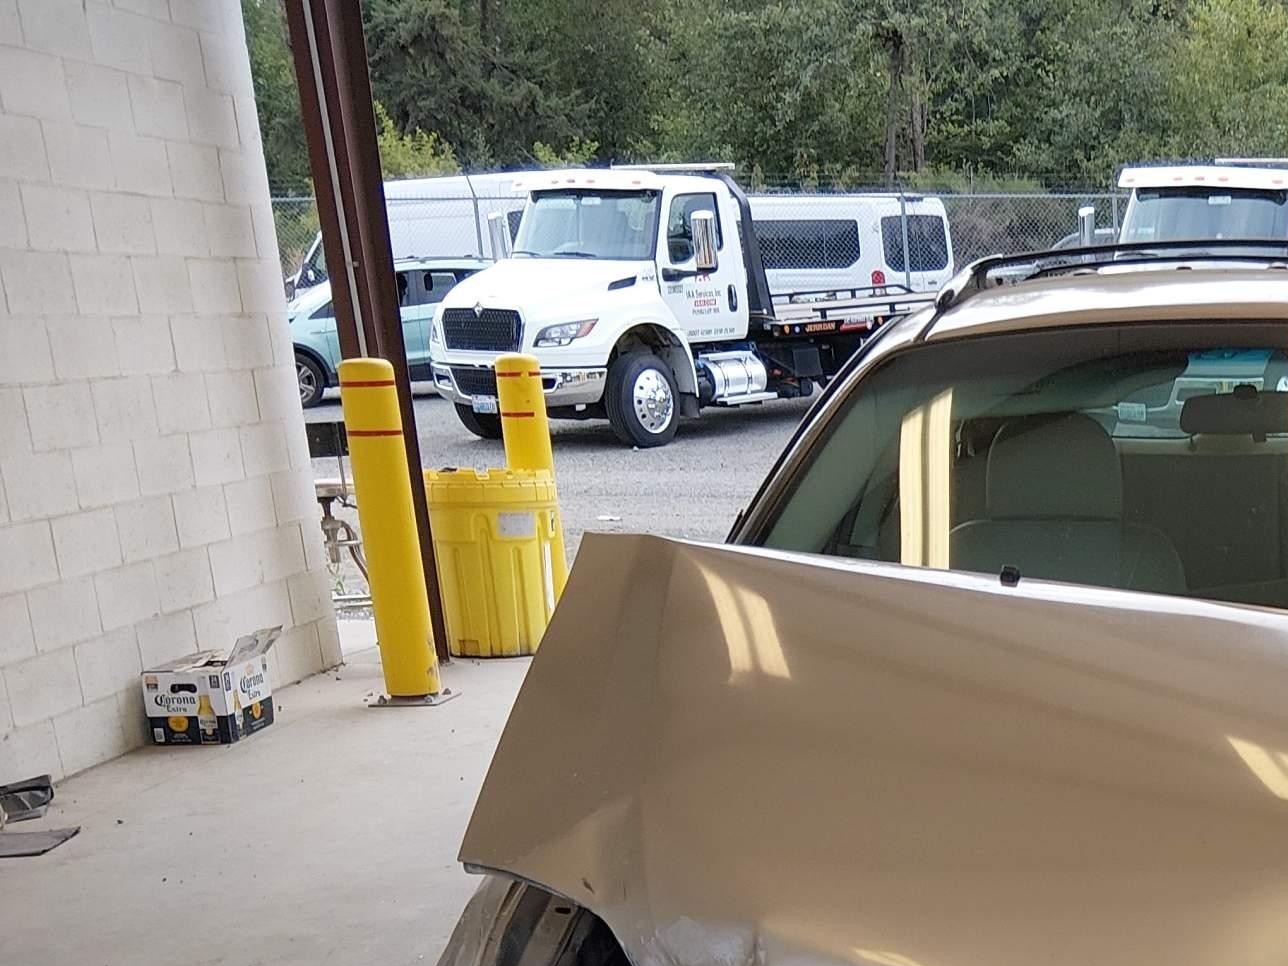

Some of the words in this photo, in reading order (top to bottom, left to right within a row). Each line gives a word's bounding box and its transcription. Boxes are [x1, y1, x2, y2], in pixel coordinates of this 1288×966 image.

[240, 671, 264, 694] Corona
[247, 688, 261, 700] Extra
[154, 694, 196, 708] Corona
[166, 705, 187, 713] Extra
